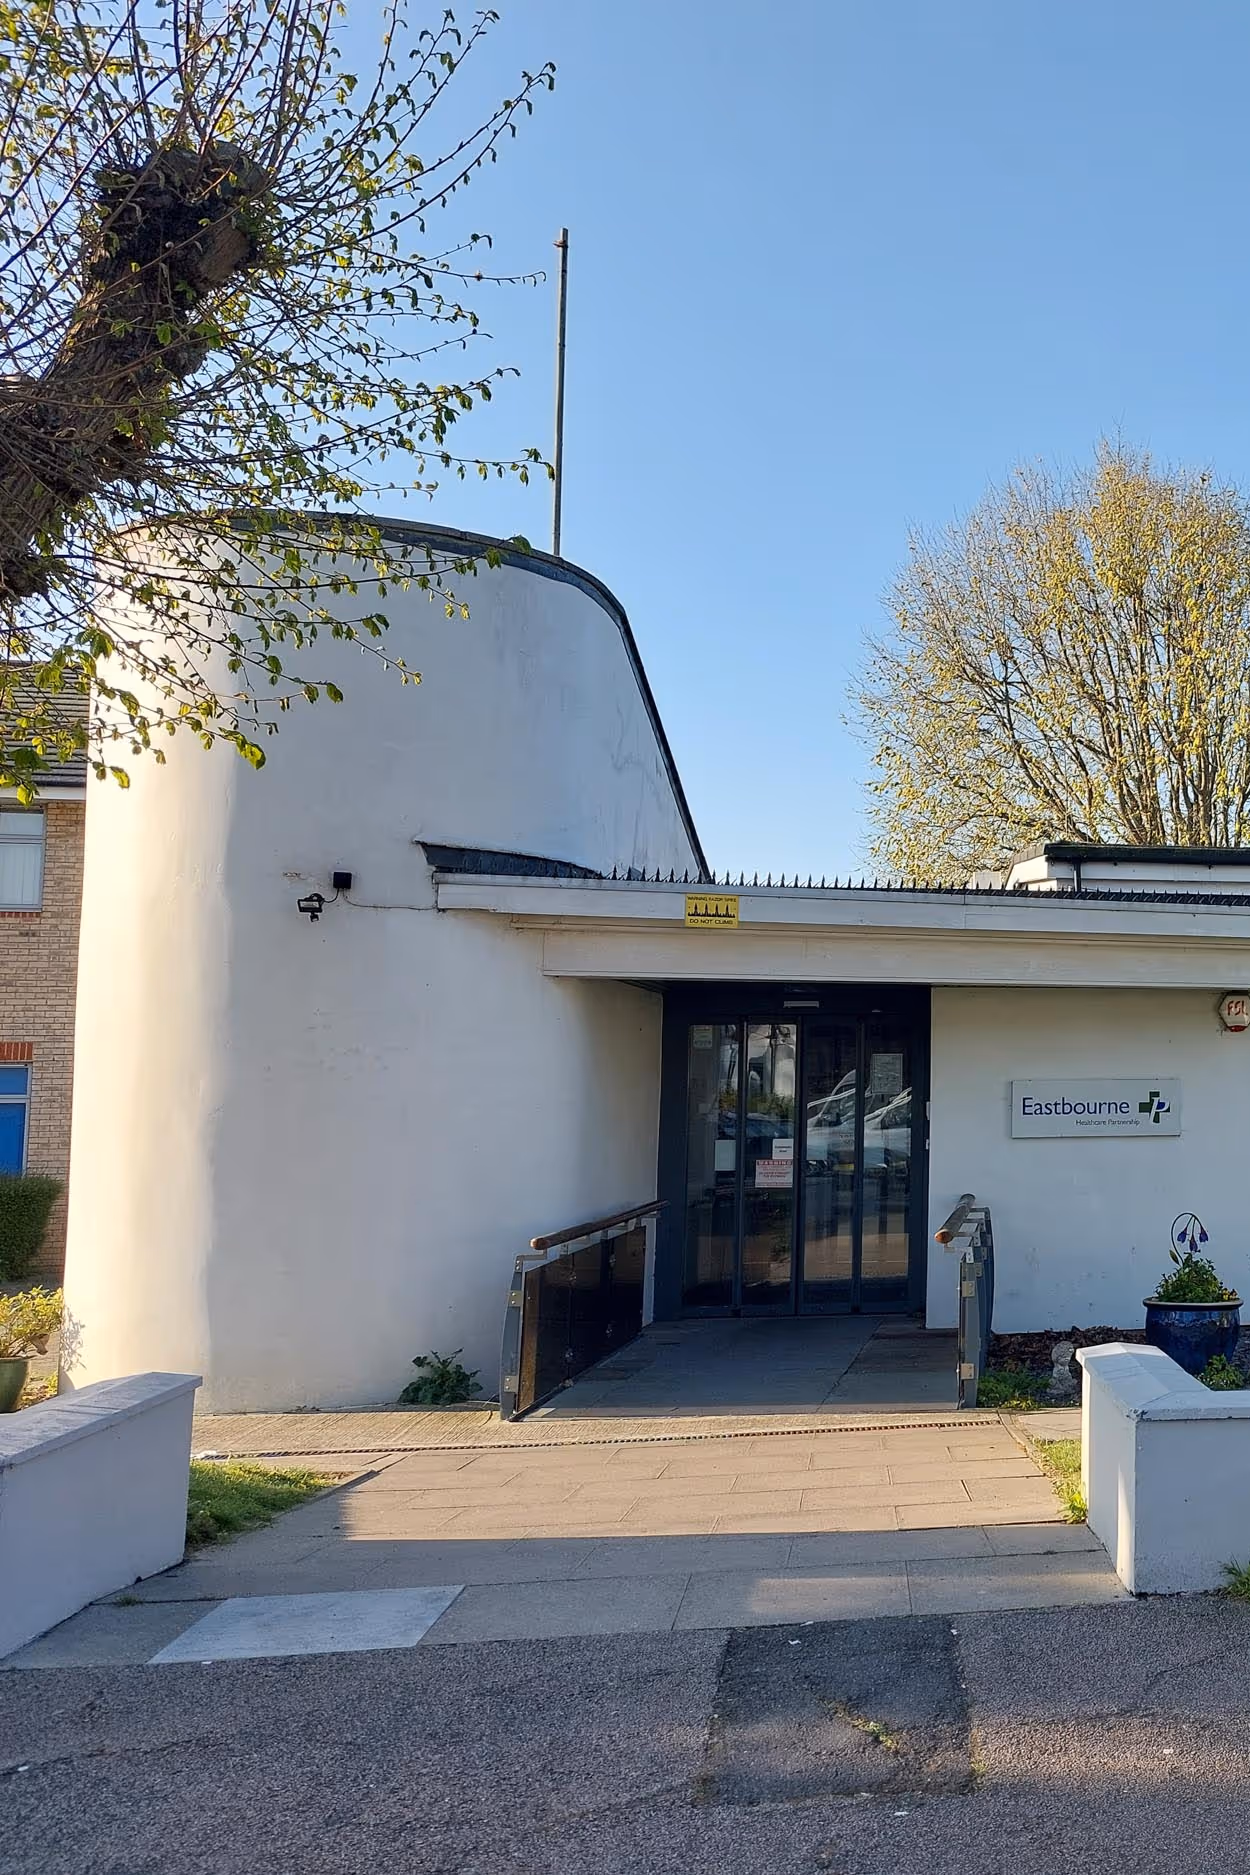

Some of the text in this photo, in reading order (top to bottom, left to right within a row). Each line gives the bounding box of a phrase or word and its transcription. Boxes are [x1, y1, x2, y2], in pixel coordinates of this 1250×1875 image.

[1022, 1096, 1130, 1116] Eastbourne
[1075, 1118, 1141, 1127] Healthcare Partnership
